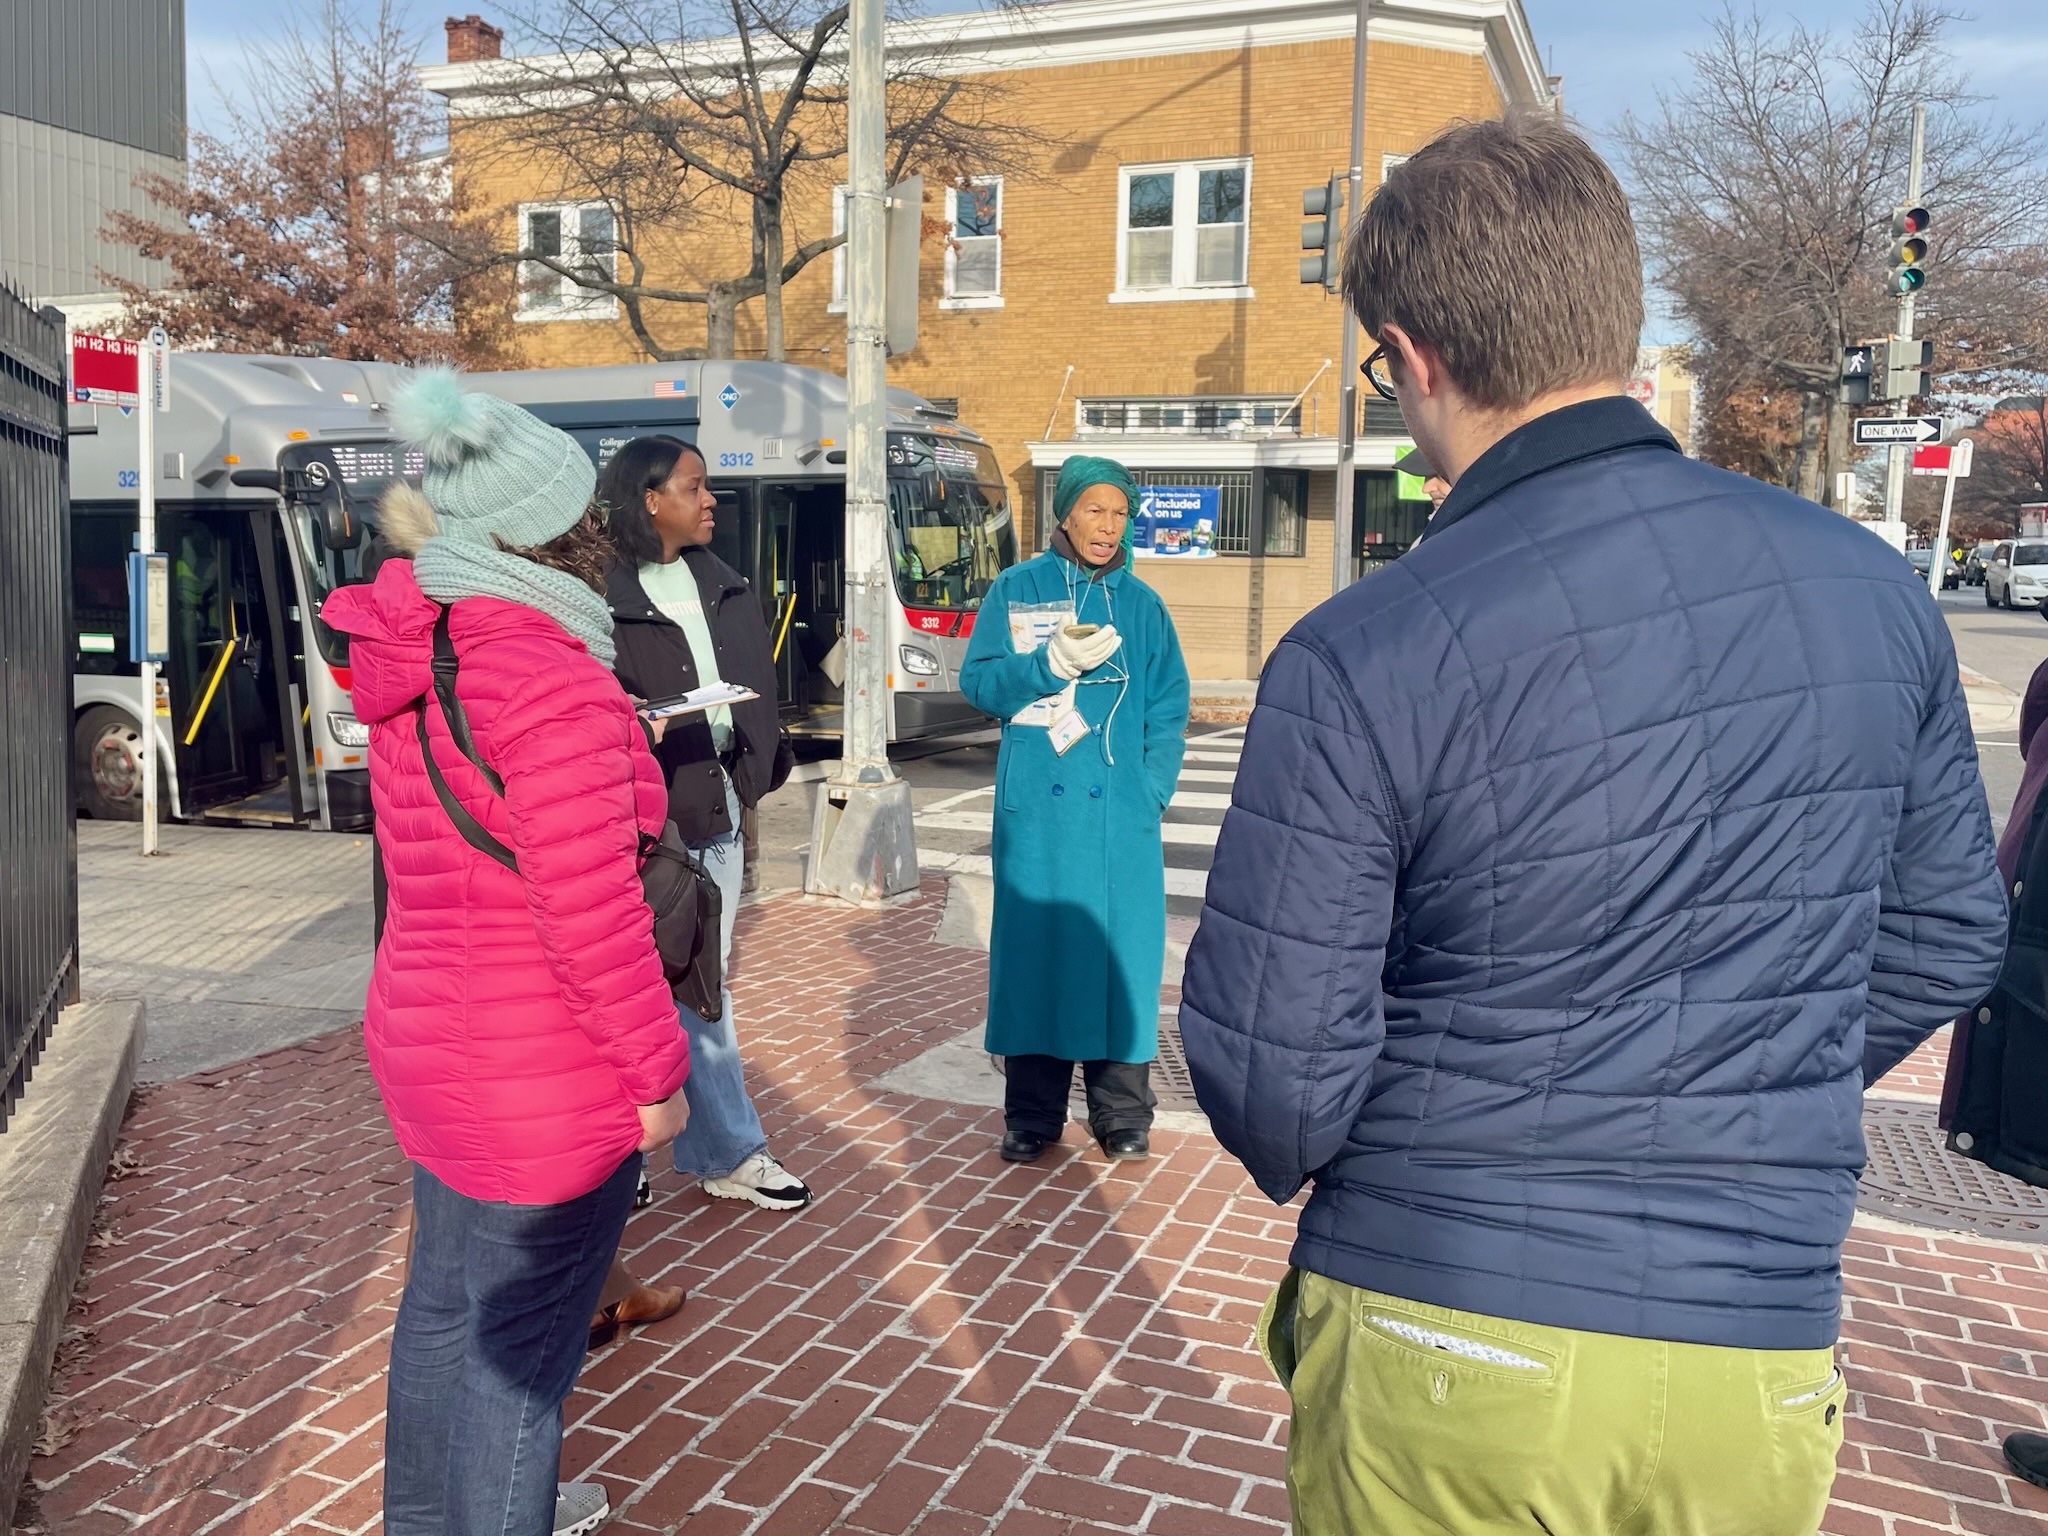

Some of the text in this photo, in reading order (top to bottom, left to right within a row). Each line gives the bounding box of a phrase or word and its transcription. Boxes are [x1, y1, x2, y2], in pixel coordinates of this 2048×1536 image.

[75, 335, 138, 357] H1 H2 H3 H4
[155, 349, 163, 408] metrobus
[720, 392, 738, 401] CNG
[1864, 426, 1915, 437] ONE WAY
[599, 437, 626, 449] College
[719, 452, 754, 467] 3312
[1157, 499, 1200, 509] included
[1156, 510, 1182, 518] on us
[921, 616, 940, 629] 3312
